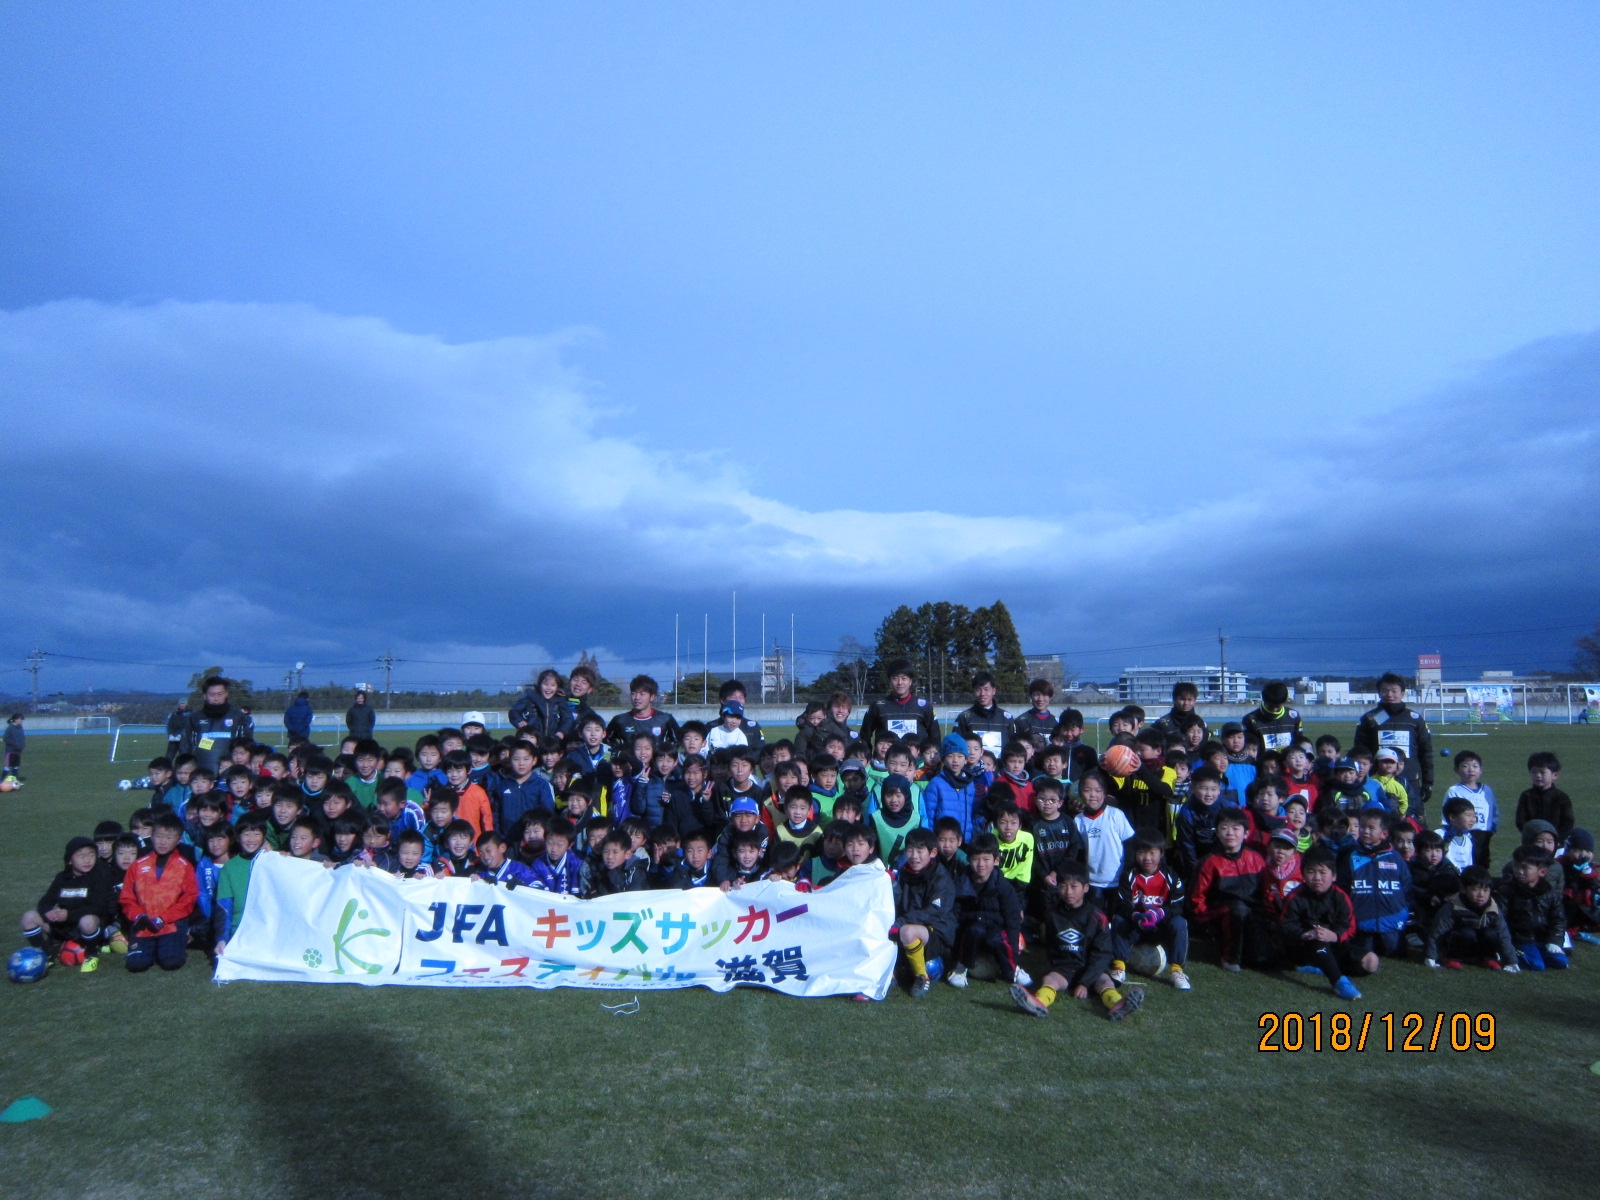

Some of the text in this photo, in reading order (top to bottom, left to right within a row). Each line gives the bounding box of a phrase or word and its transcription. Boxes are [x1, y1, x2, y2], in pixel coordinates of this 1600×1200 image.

[415, 901, 809, 956] JFA キッズサッカー
[715, 945, 810, 984] 滋賀
